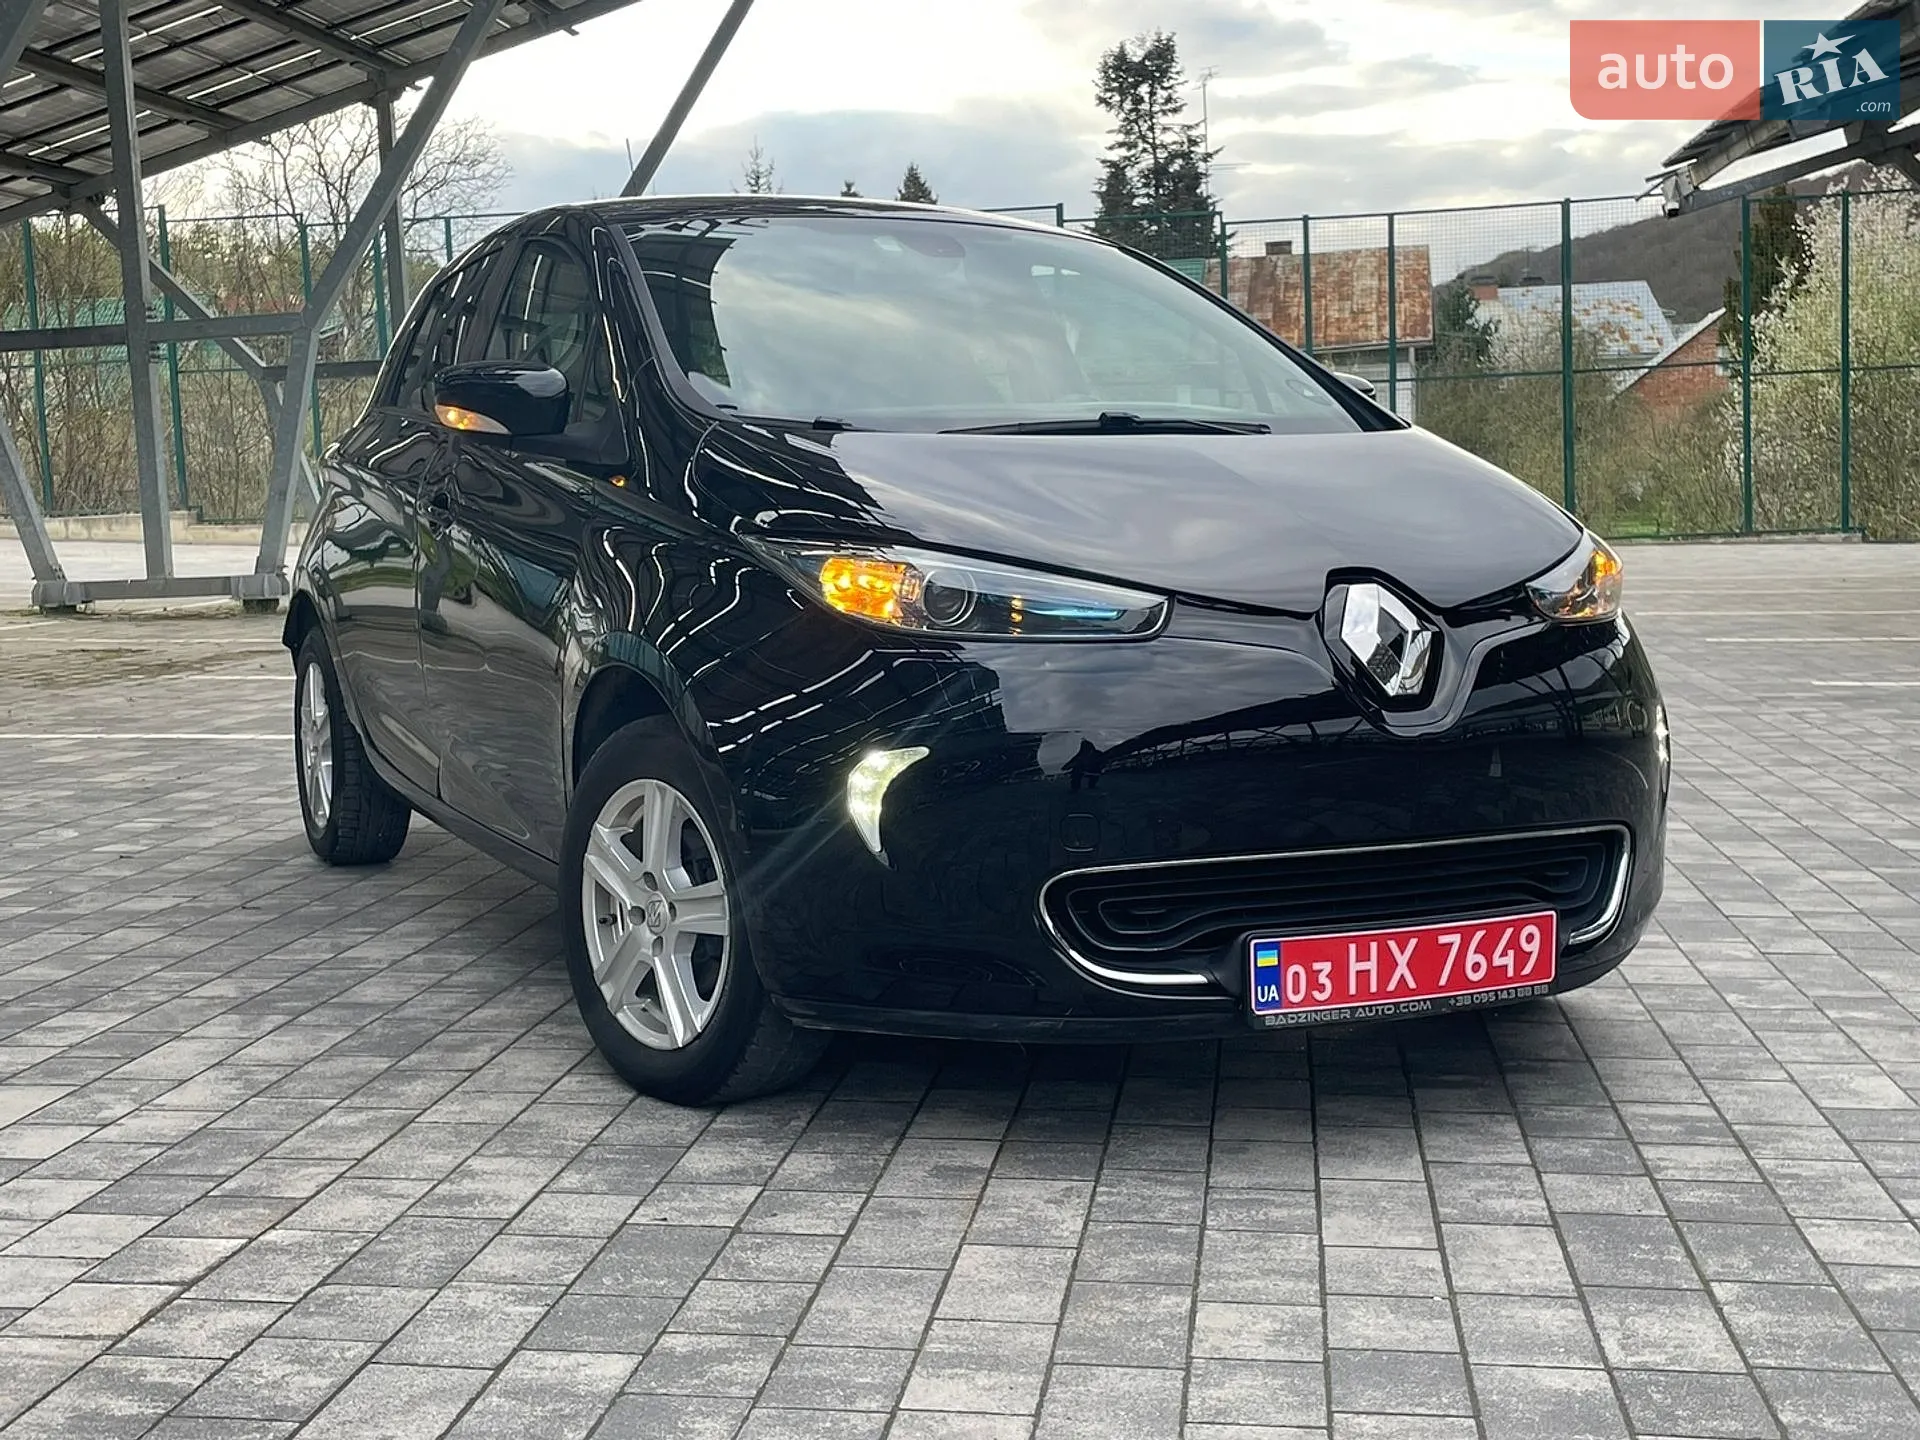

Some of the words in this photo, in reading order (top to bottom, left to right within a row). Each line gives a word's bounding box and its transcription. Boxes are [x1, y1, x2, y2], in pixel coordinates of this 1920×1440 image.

[1286, 961, 1332, 1003] 03
[1348, 938, 1419, 995] HX
[1438, 924, 1541, 986] 7649
[1257, 985, 1279, 1002] UA
[1265, 1009, 1350, 1026] BADZINGER
